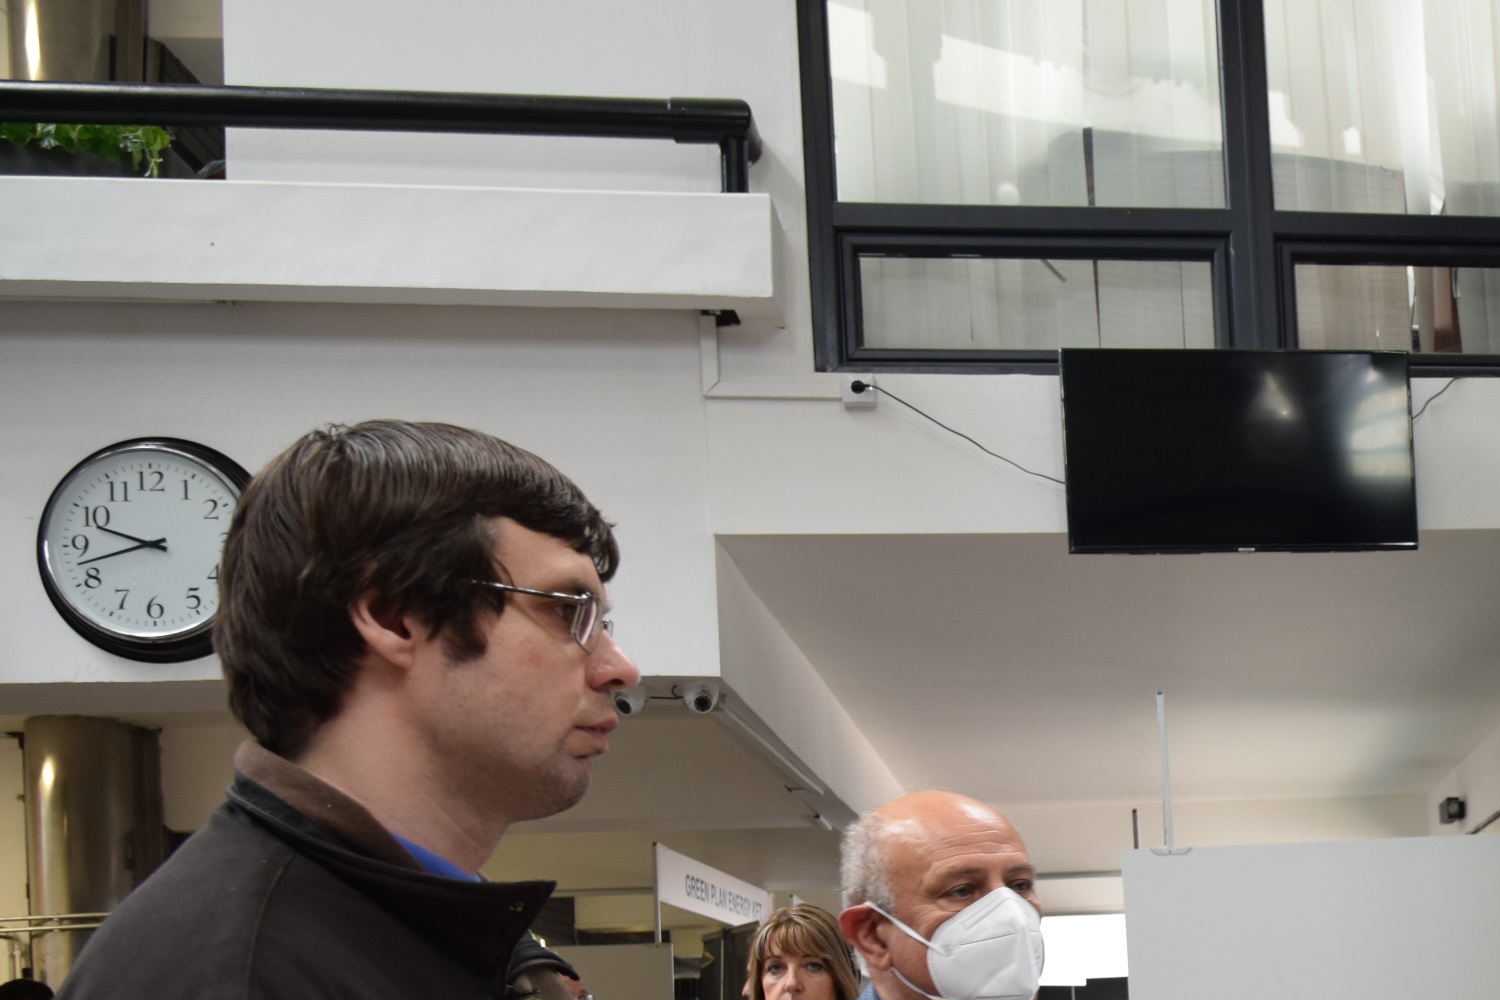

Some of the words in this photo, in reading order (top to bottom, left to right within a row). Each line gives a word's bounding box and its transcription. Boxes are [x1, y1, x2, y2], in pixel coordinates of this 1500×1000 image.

[108, 481, 131, 502] 11
[137, 470, 165, 492] 12
[181, 479, 191, 500] 1
[83, 505, 110, 528] 10
[202, 499, 219, 520] 2
[71, 535, 89, 558] 9
[84, 567, 102, 589] 8
[115, 589, 130, 610] 7
[147, 595, 164, 619] 6
[186, 587, 201, 609] 5
[686, 874, 709, 902] GREEN
[711, 884, 727, 910] PLAN
[729, 893, 751, 918] ENERGY
